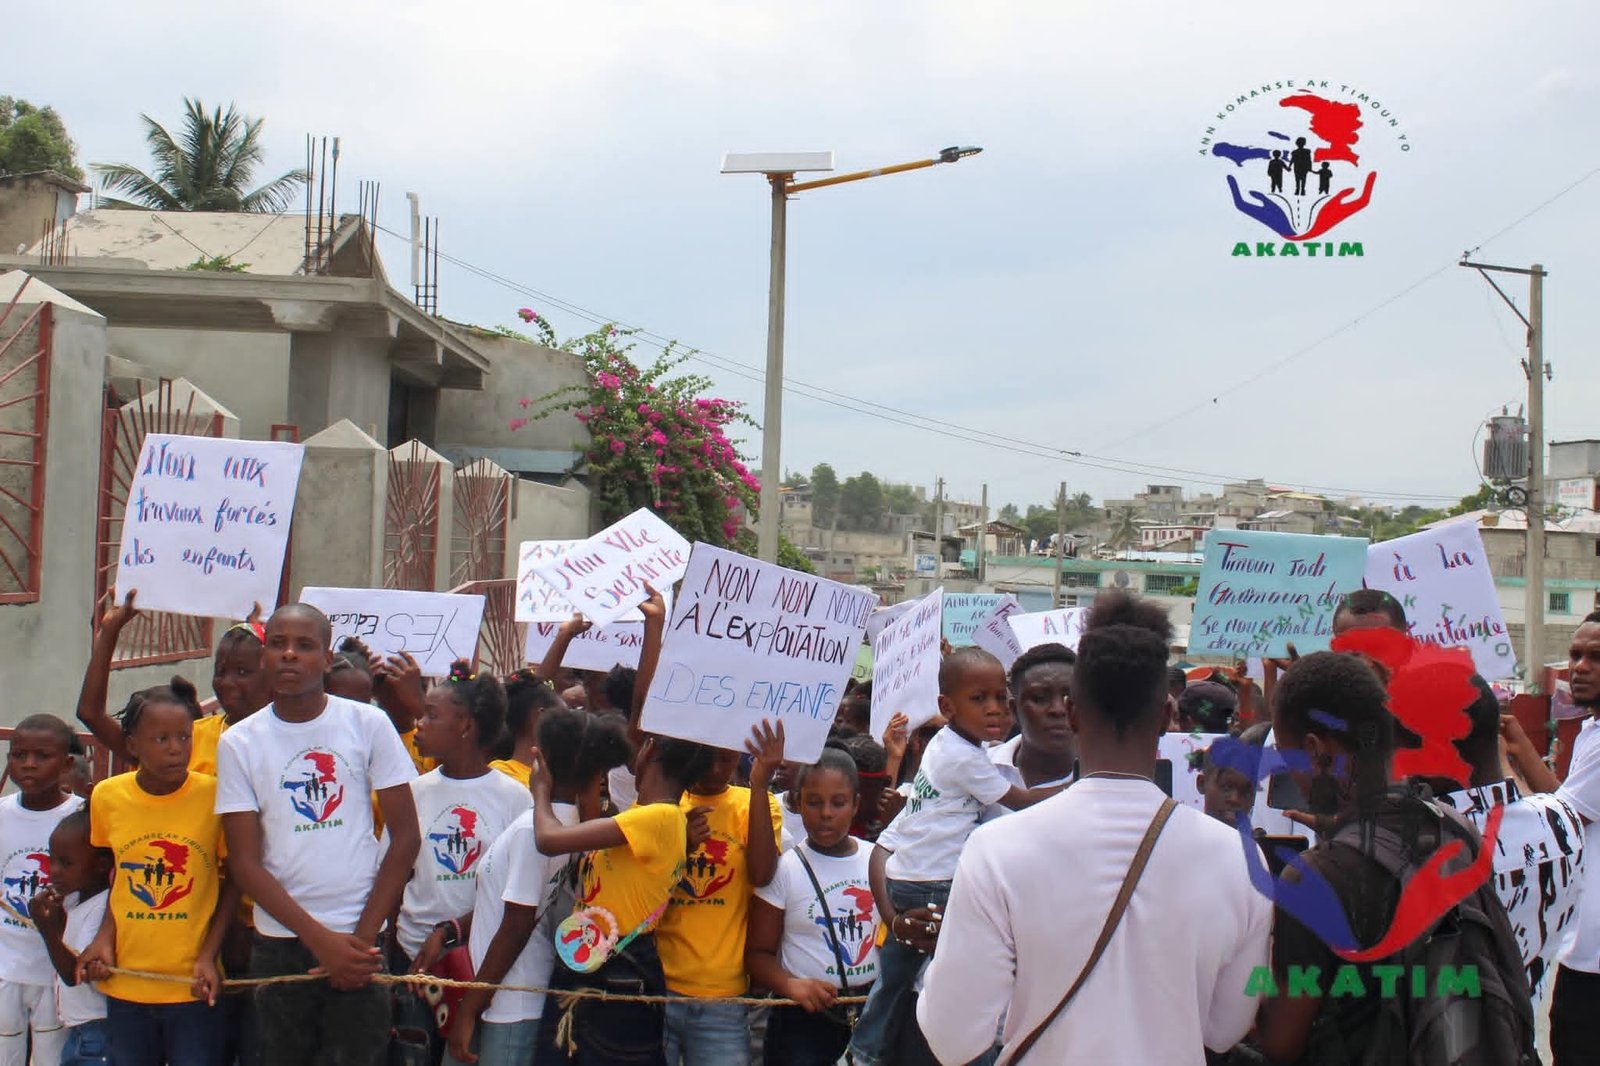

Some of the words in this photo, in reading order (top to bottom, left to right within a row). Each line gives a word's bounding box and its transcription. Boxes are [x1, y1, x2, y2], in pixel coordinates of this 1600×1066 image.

[136, 486, 204, 525] travaux
[214, 496, 277, 533] forcés
[181, 546, 256, 576] enfants
[1217, 542, 1275, 576] Timoun
[1392, 551, 1417, 582] à
[703, 559, 761, 604] NON
[772, 577, 819, 618] NON
[675, 591, 701, 632] À
[384, 608, 459, 665] YES
[650, 662, 737, 708] DES
[746, 680, 837, 722] ENFANTS
[293, 818, 344, 834] AKATIM
[126, 911, 188, 921] AKATIM
[825, 962, 875, 976] AATIM
